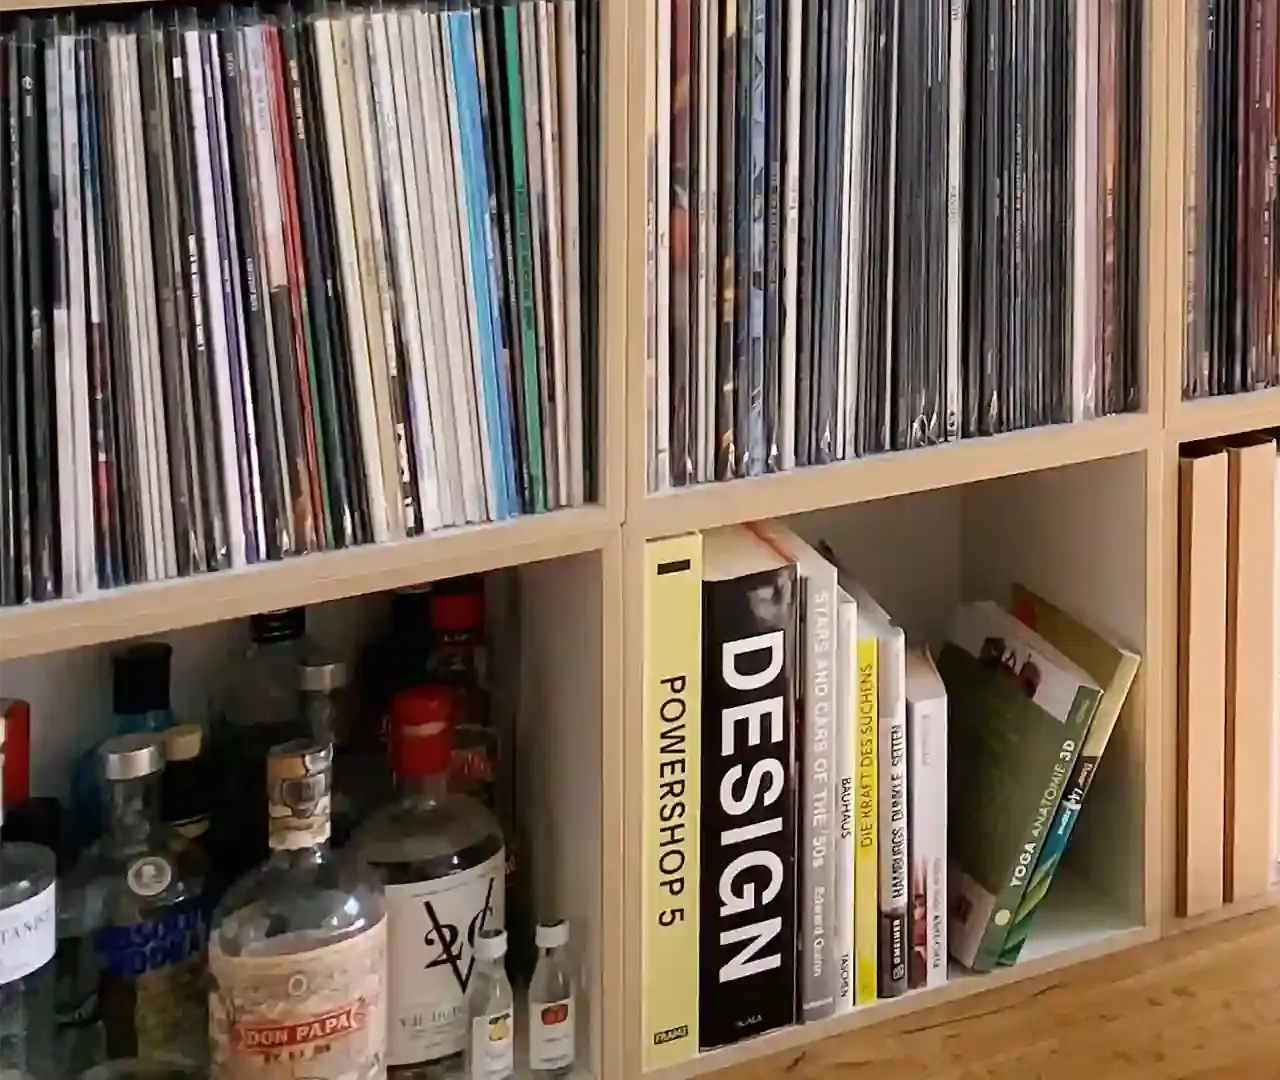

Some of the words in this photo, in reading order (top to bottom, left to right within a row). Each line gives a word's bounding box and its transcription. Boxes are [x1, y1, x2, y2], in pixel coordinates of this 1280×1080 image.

[813, 591, 830, 654] STARS
[813, 658, 828, 697] AND
[860, 662, 874, 736] SUCHENS
[812, 701, 828, 751] CARS
[812, 758, 828, 783] OF
[860, 739, 874, 768] DES
[658, 676, 686, 897] POWERSHOP
[718, 631, 785, 984] DESIGN
[812, 789, 828, 826] THE
[840, 776, 853, 840] BAUHAUS
[860, 771, 874, 818] KRAFT
[860, 821, 873, 848] DIE
[1008, 841, 1037, 888] YOGA
[1029, 763, 1066, 837] ANATOMIE
[1060, 739, 1077, 762] 3D
[658, 906, 685, 927] 5
[839, 953, 850, 999] TASCHEN
[246, 1027, 288, 1046] DON
[296, 1009, 349, 1042] PAPA
